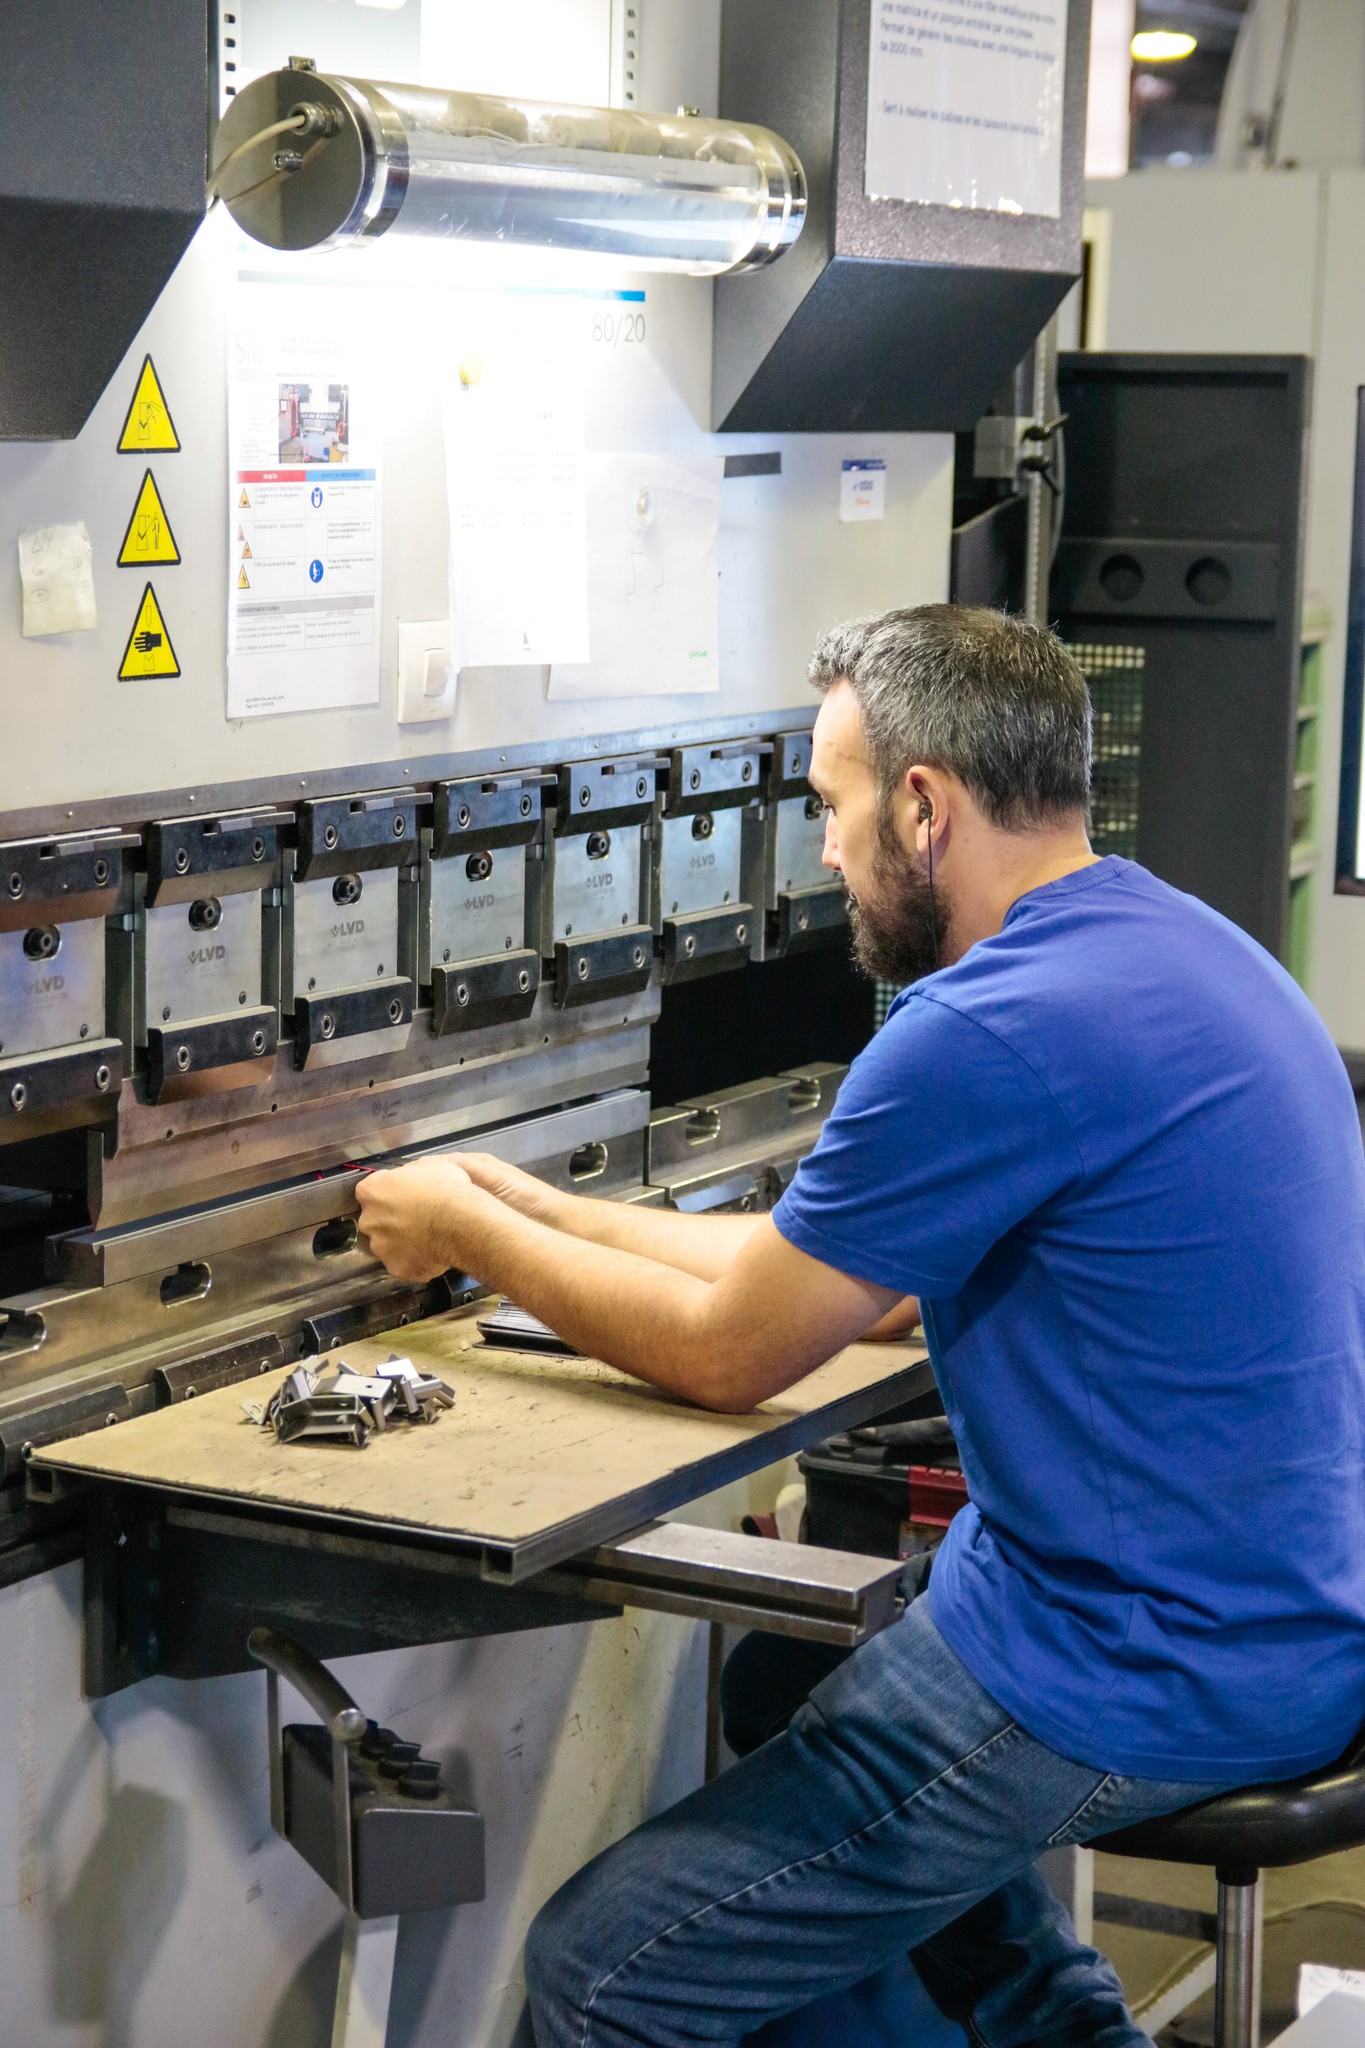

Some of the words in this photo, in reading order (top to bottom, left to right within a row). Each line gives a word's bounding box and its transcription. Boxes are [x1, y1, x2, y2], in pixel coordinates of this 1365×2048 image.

[592, 313, 646, 349] 80/20
[697, 853, 715, 868] LVD
[593, 872, 613, 887] LVD
[473, 893, 495, 909] LVD
[341, 919, 365, 936] LVD
[199, 945, 226, 963] LVD
[34, 974, 65, 994] LVD
